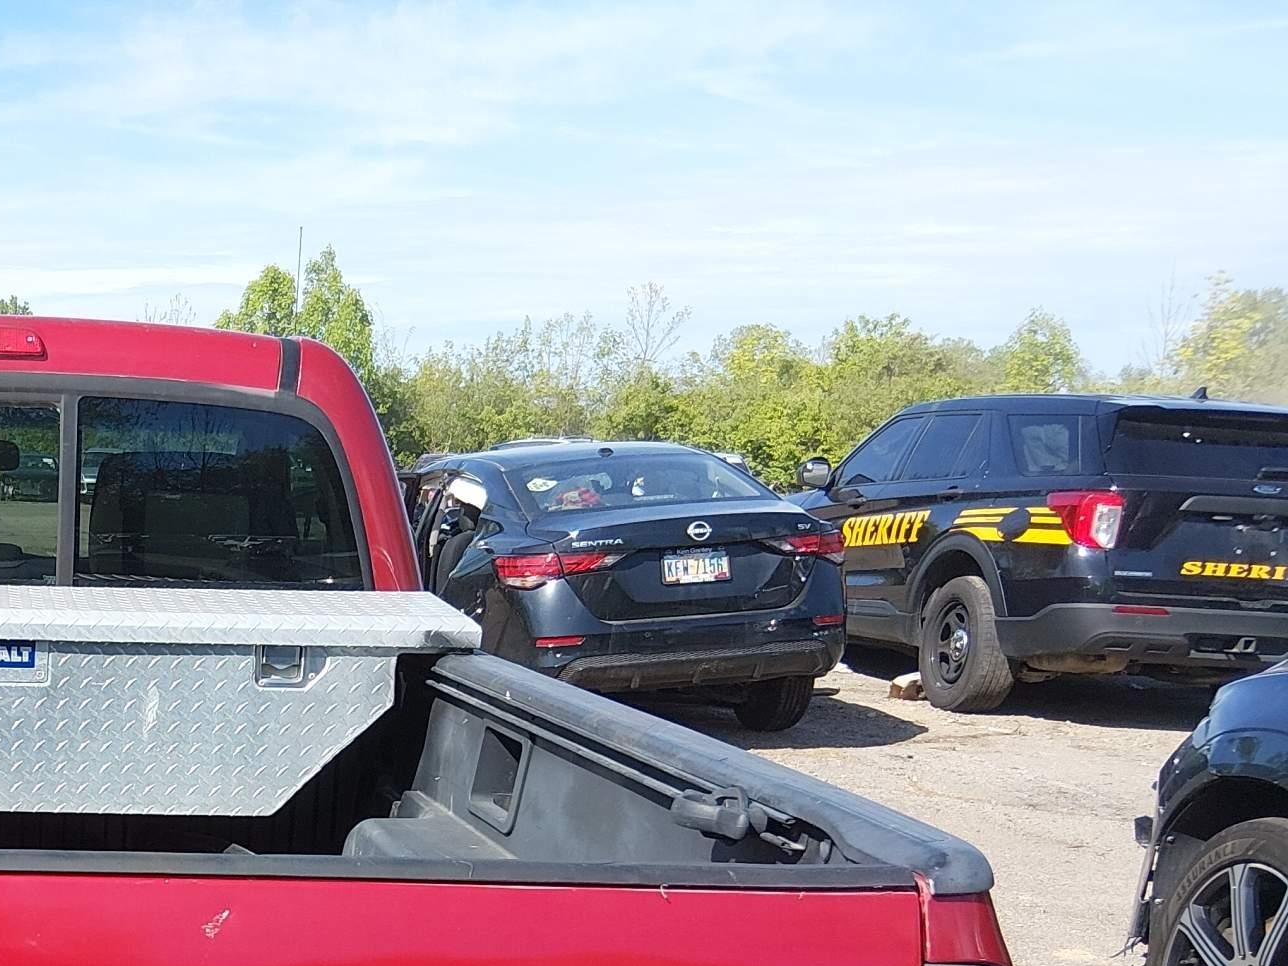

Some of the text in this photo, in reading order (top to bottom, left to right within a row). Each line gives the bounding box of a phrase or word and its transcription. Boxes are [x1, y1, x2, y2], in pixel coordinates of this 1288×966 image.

[797, 523, 812, 531] SV
[842, 510, 932, 547] SHERIFF
[571, 537, 625, 549] SENTRA
